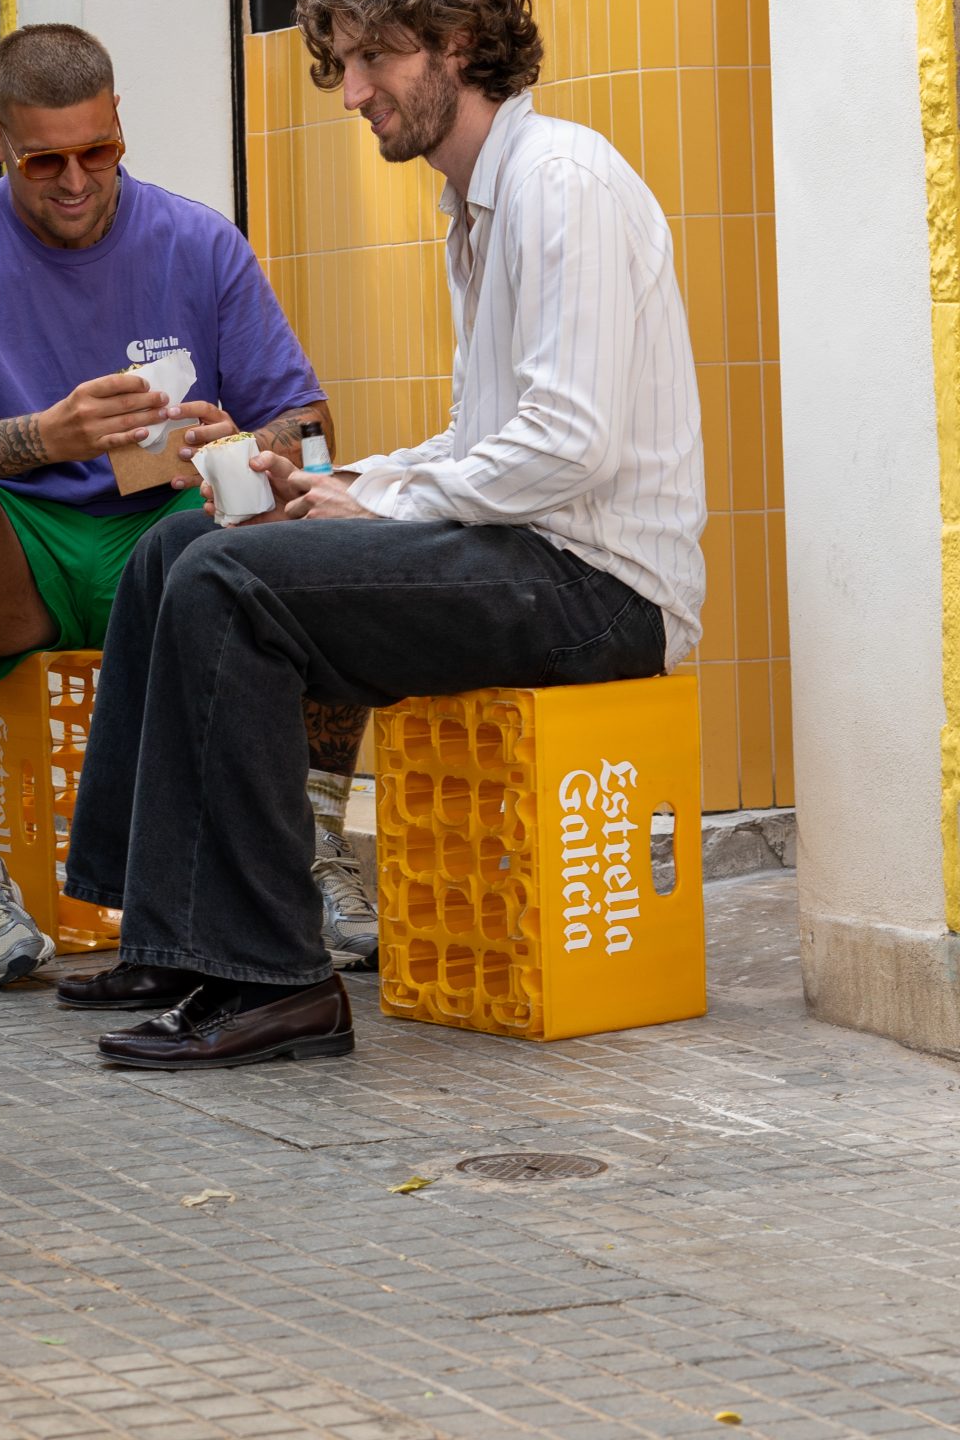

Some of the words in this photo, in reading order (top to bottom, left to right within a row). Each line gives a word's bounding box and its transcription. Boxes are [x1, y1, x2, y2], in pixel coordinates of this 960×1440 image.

[144, 337, 169, 349] Work
[169, 336, 179, 347] In
[558, 770, 602, 954] Galicia
[600, 758, 641, 956] Estrella
